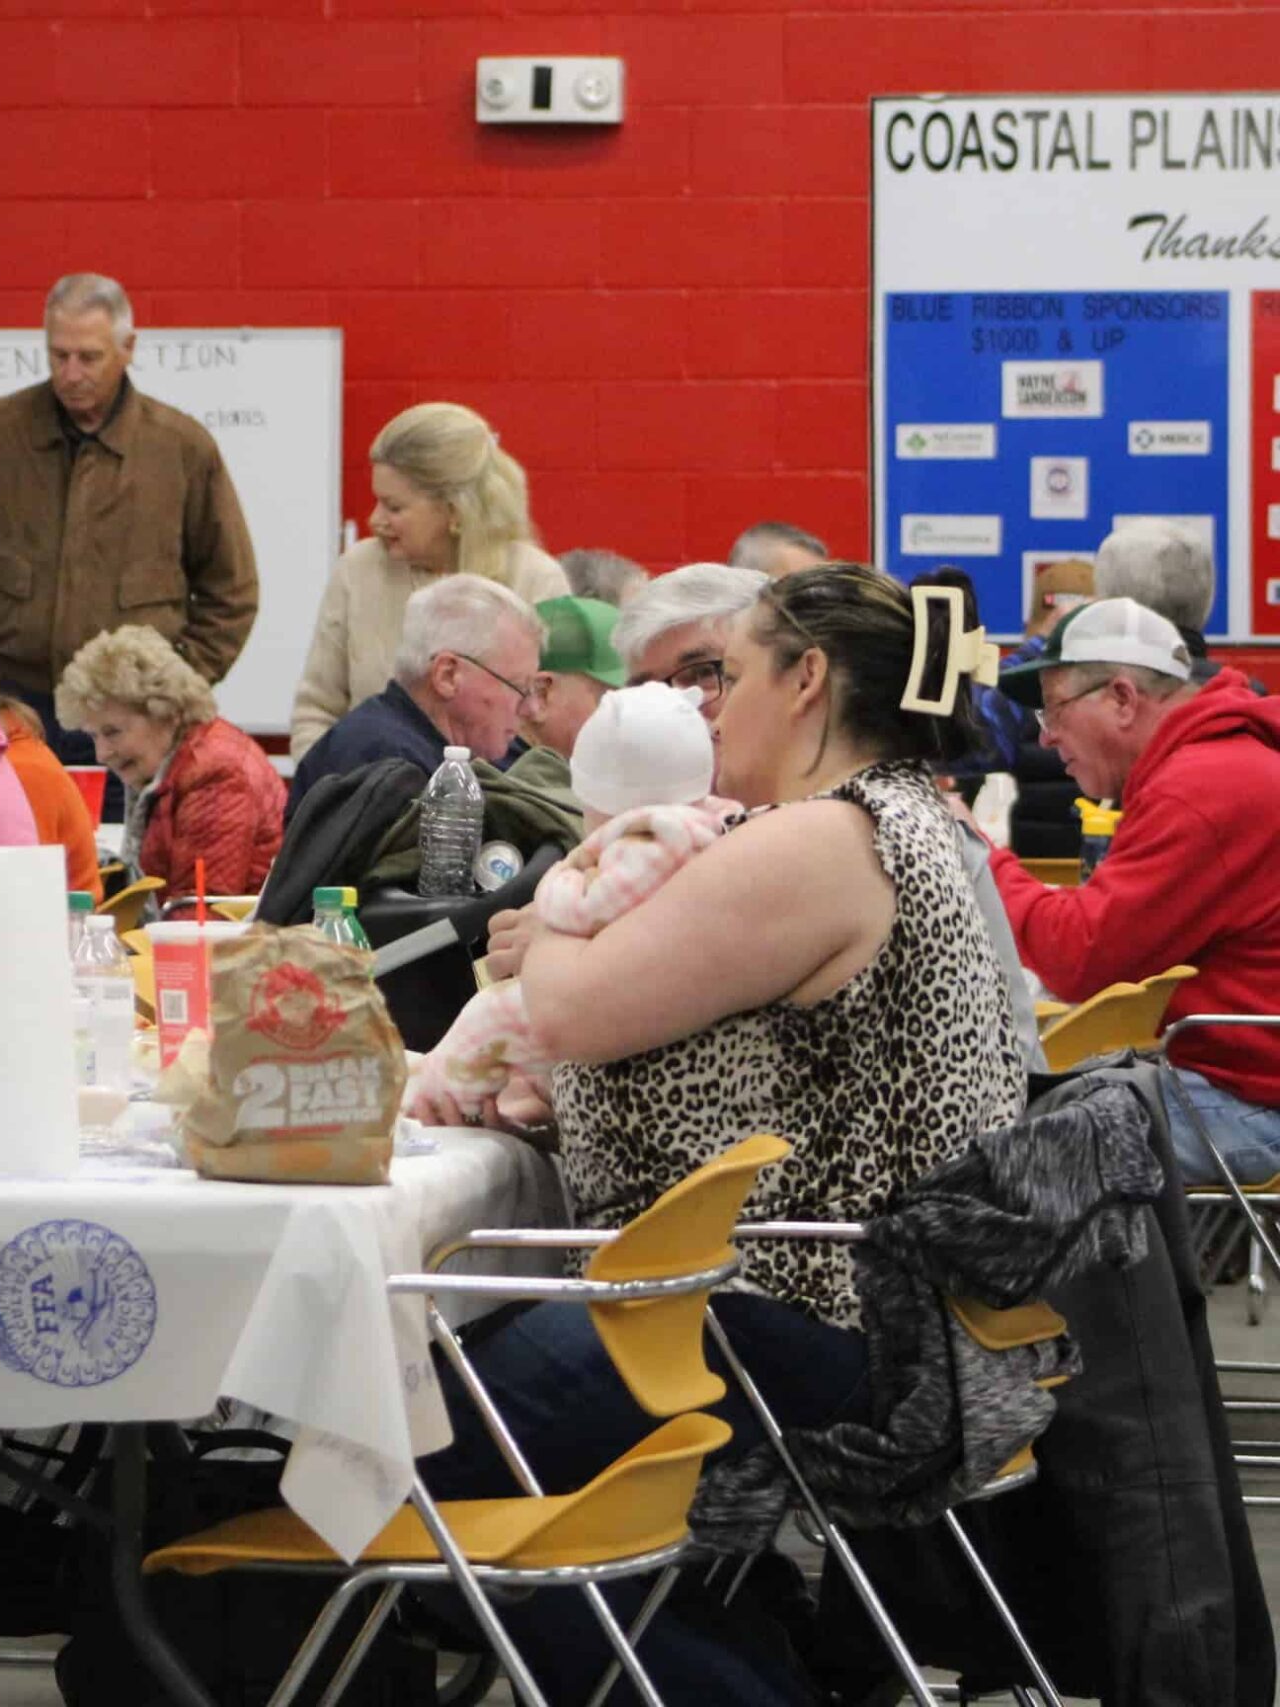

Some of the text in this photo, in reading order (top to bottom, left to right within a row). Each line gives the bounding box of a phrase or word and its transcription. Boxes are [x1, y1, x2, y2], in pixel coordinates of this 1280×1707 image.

[886, 110, 1111, 172] COASTAL
[892, 294, 1221, 322] BLUE RIBBON SPONSORS
[972, 327, 1040, 353] $1000
[1092, 327, 1126, 353] UP
[232, 1063, 287, 1130] 2
[289, 1074, 381, 1111] FAST
[30, 1273, 60, 1334] FFA
